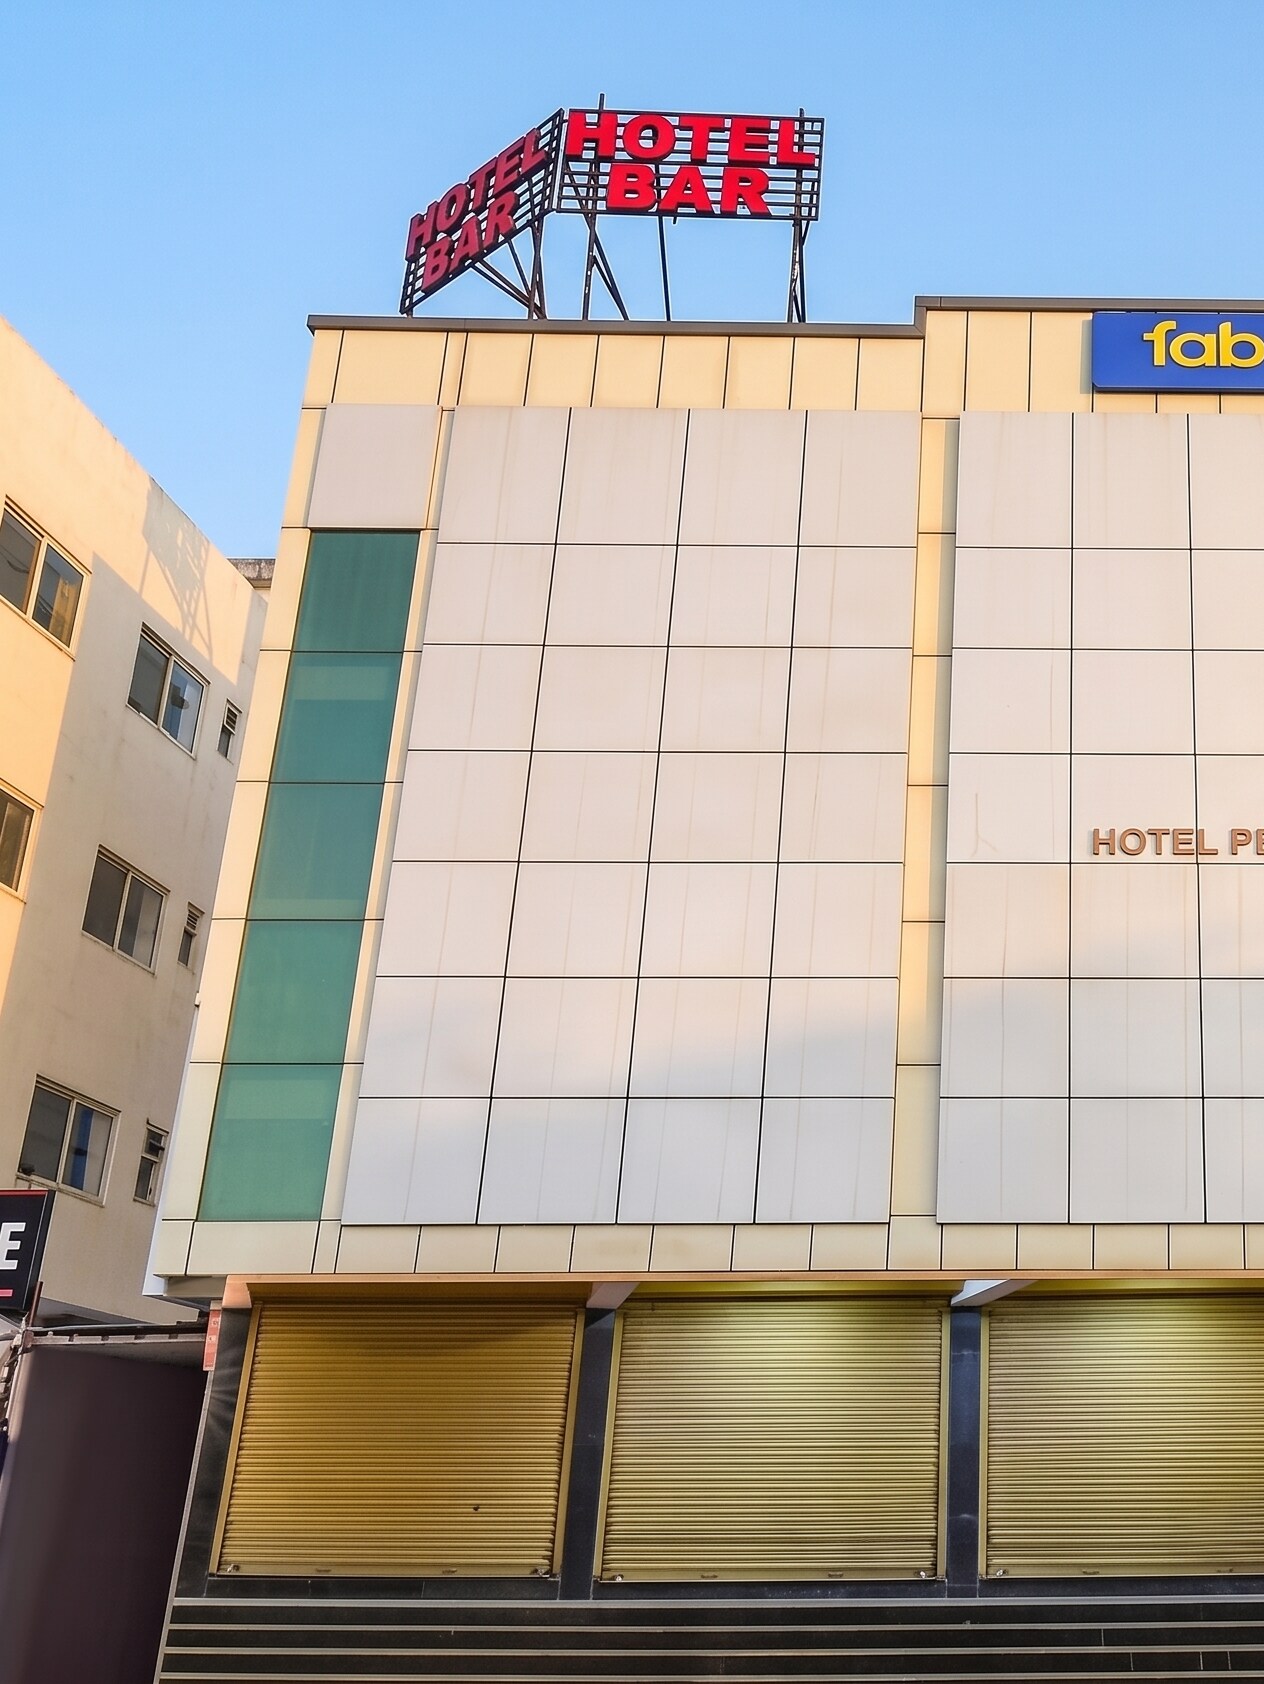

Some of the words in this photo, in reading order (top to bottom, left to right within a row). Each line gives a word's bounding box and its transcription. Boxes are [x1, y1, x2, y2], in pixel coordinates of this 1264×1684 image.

[565, 111, 817, 166] HOTEL
[405, 127, 548, 260] HOTEL
[605, 163, 772, 216] BAR
[420, 190, 519, 292] BAR
[1092, 828, 1219, 856] HOTEL
